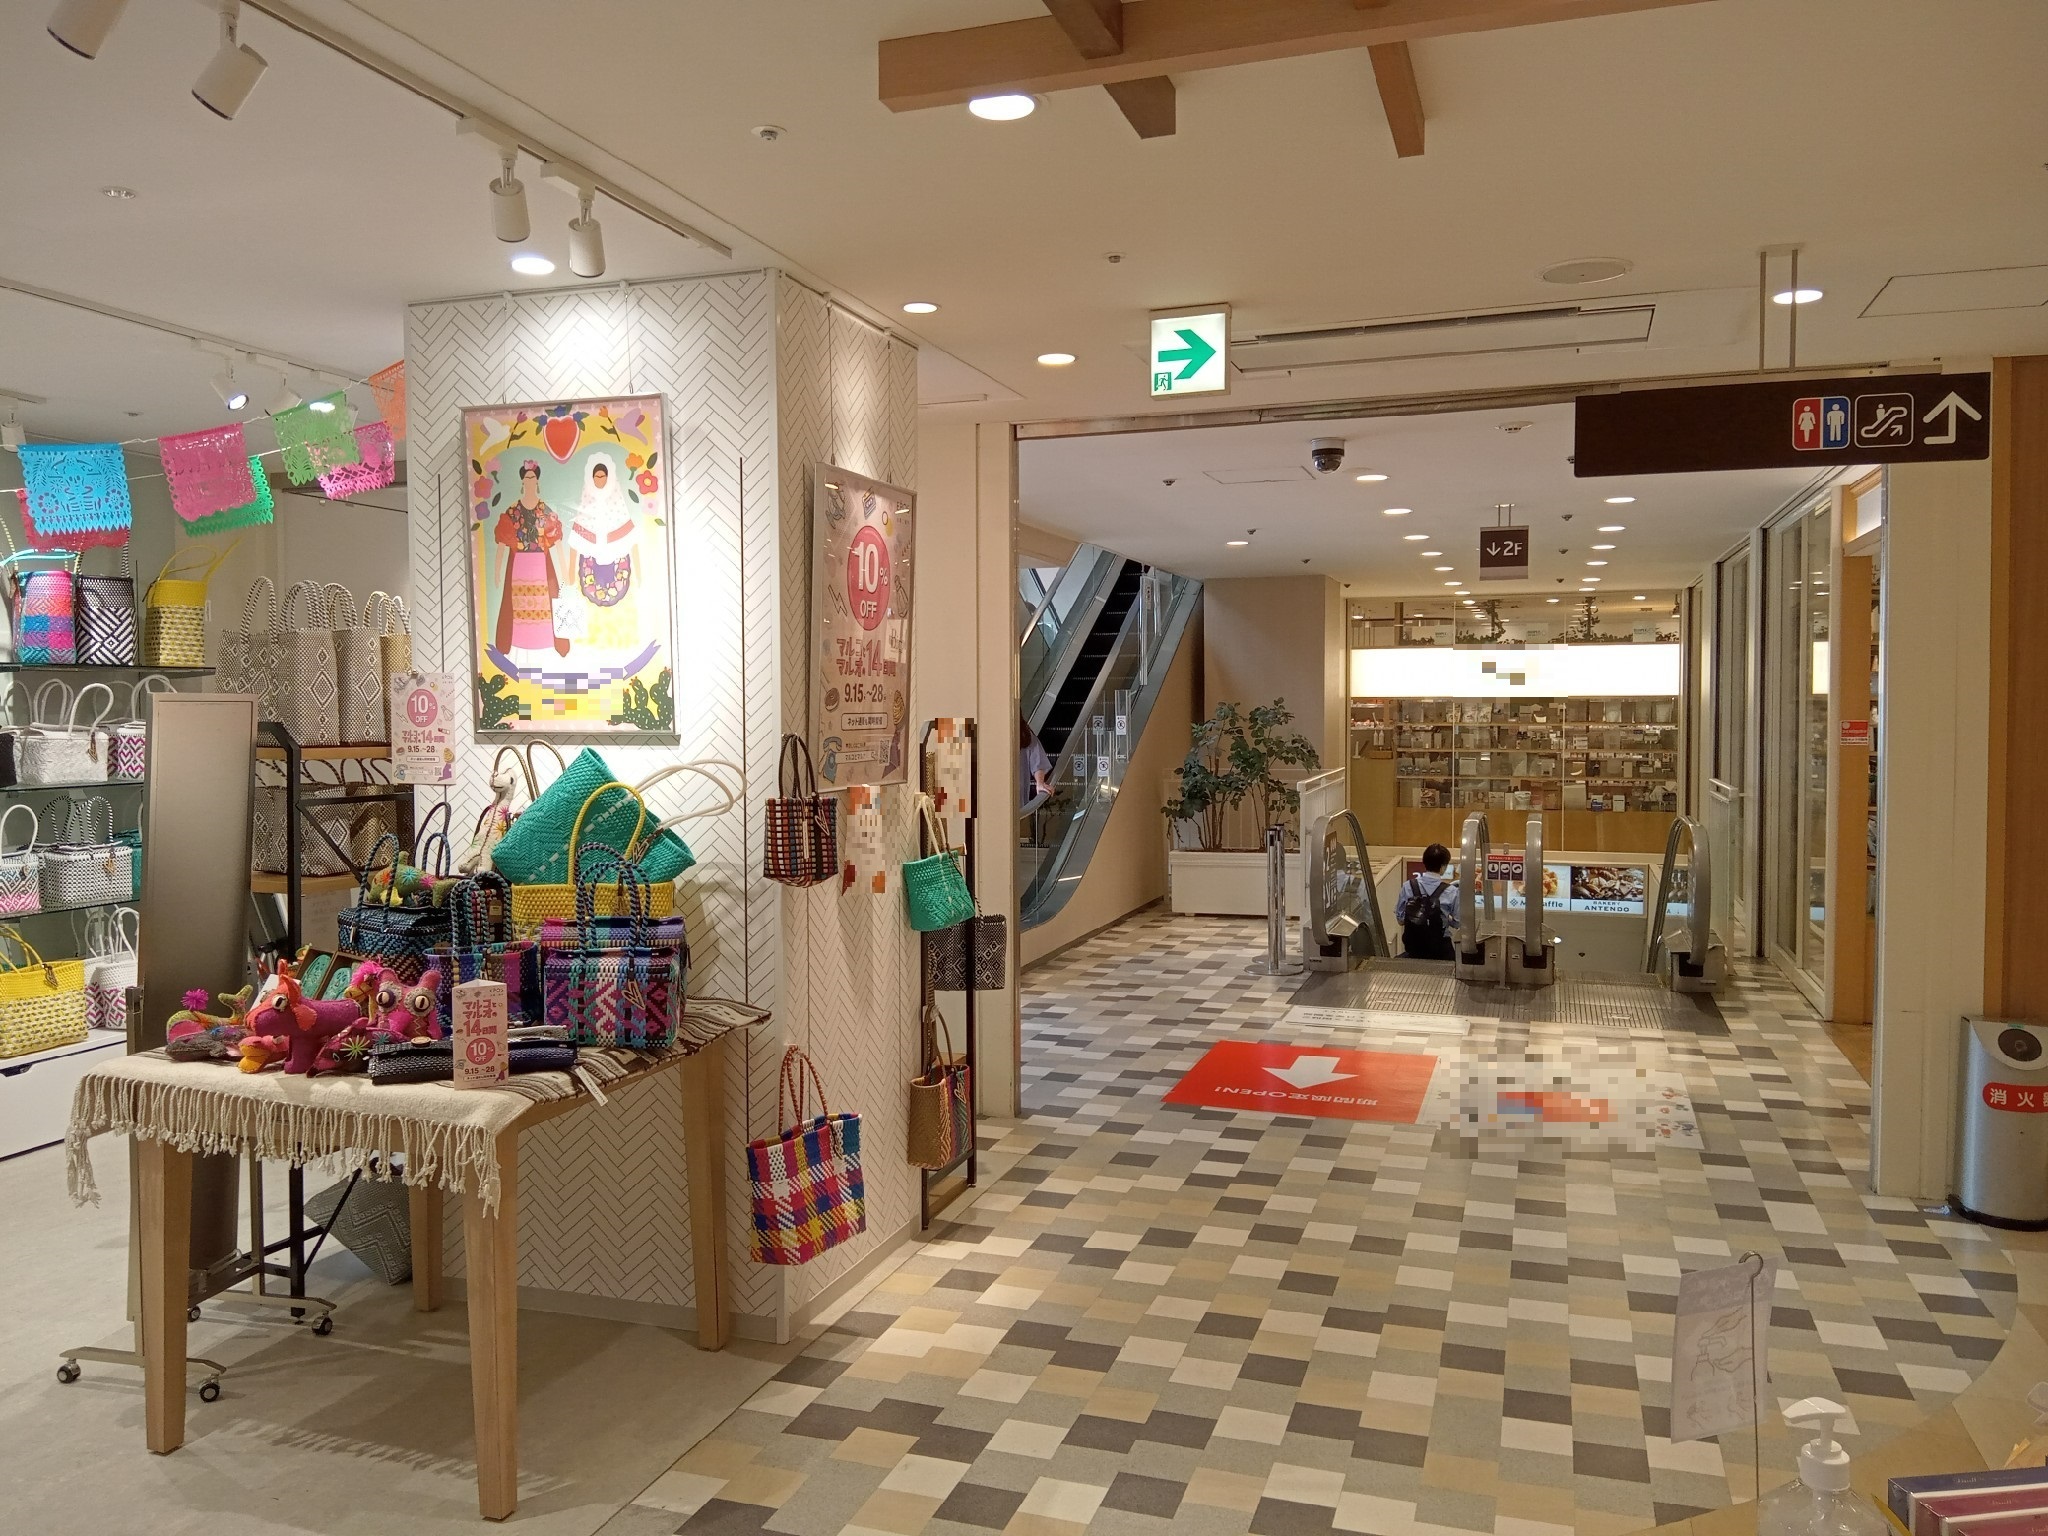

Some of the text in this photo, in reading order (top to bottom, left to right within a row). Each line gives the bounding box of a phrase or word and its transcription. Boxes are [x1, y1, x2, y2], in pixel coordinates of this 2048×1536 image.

[1503, 541, 1523, 556] 2F
[860, 599, 878, 619] OFF
[415, 715, 429, 723] OFF
[1584, 905, 1630, 913] ANTENDO
